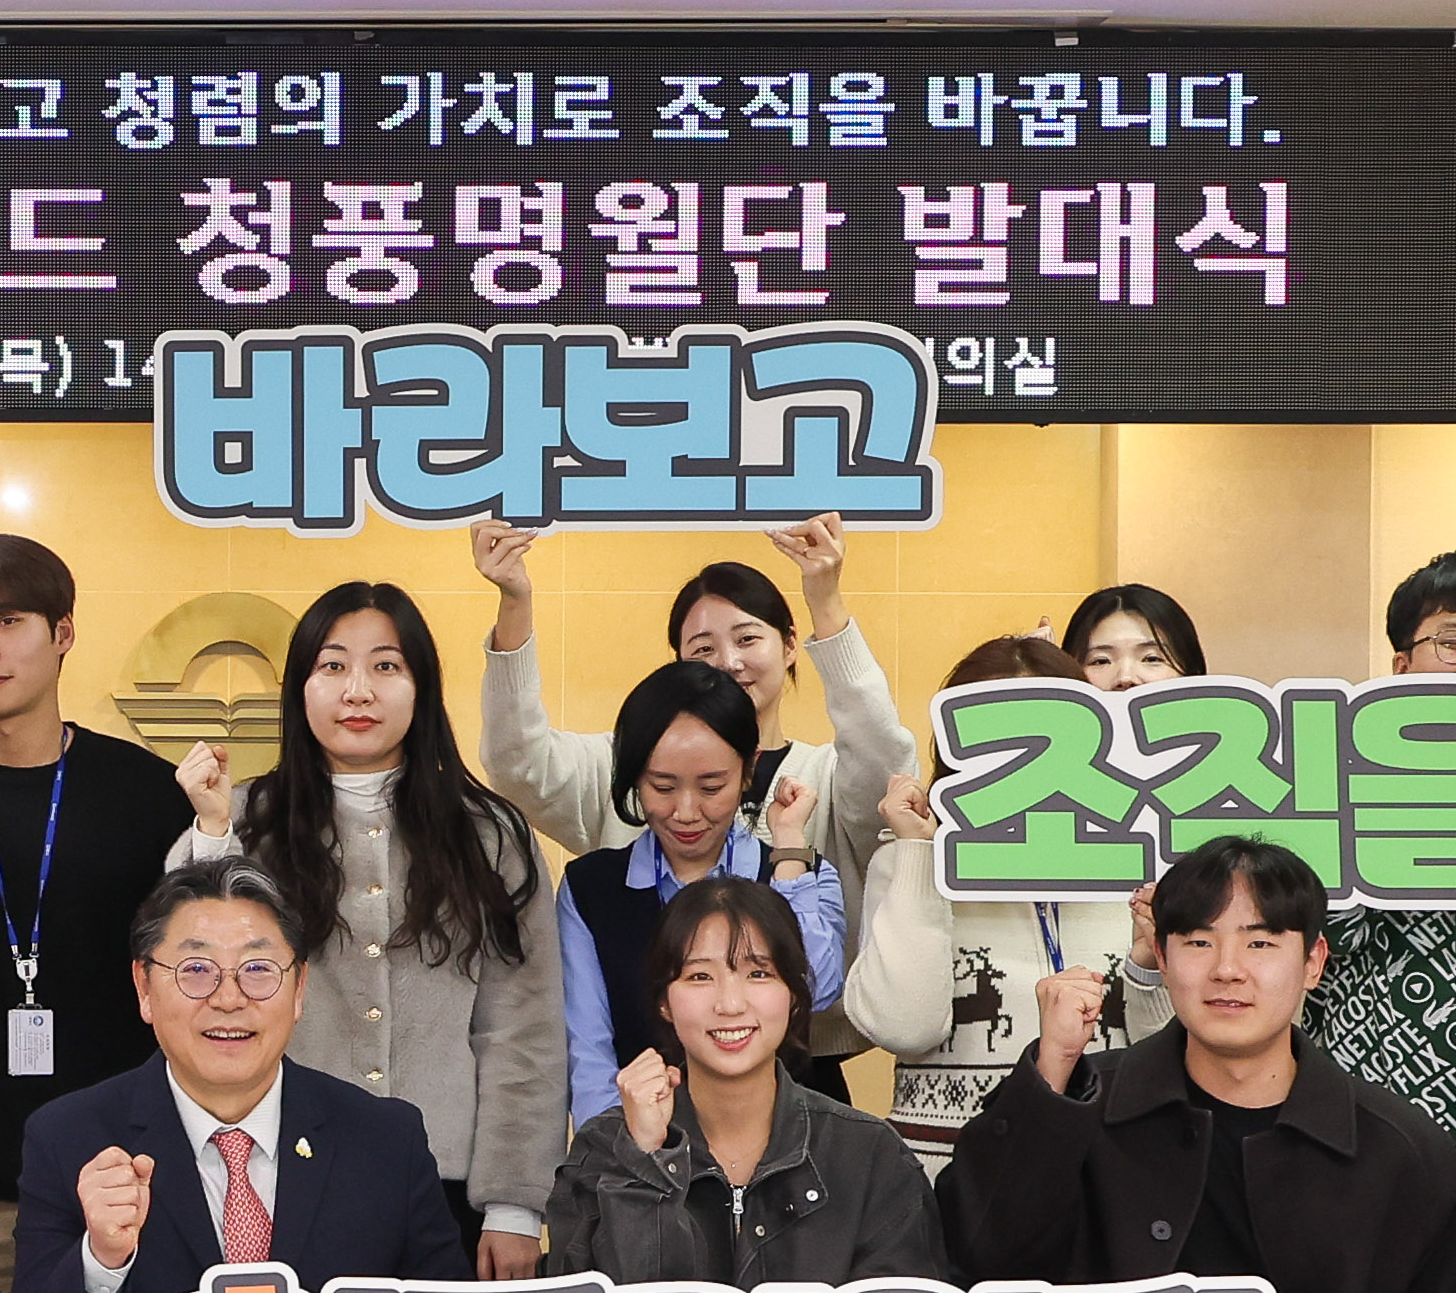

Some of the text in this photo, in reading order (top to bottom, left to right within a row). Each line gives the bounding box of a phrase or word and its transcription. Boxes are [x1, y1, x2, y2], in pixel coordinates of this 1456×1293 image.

[102, 72, 342, 149] 청렴의
[378, 72, 619, 145] 가치로
[653, 73, 895, 146] 조직을
[928, 73, 1280, 146] 바꿉니다.
[178, 178, 846, 306] 청풍명월단
[898, 182, 1290, 306] 발대식
[926, 336, 1059, 396] 의실
[170, 340, 930, 522] 바라보고
[1332, 993, 1406, 1072] NETFLIX
